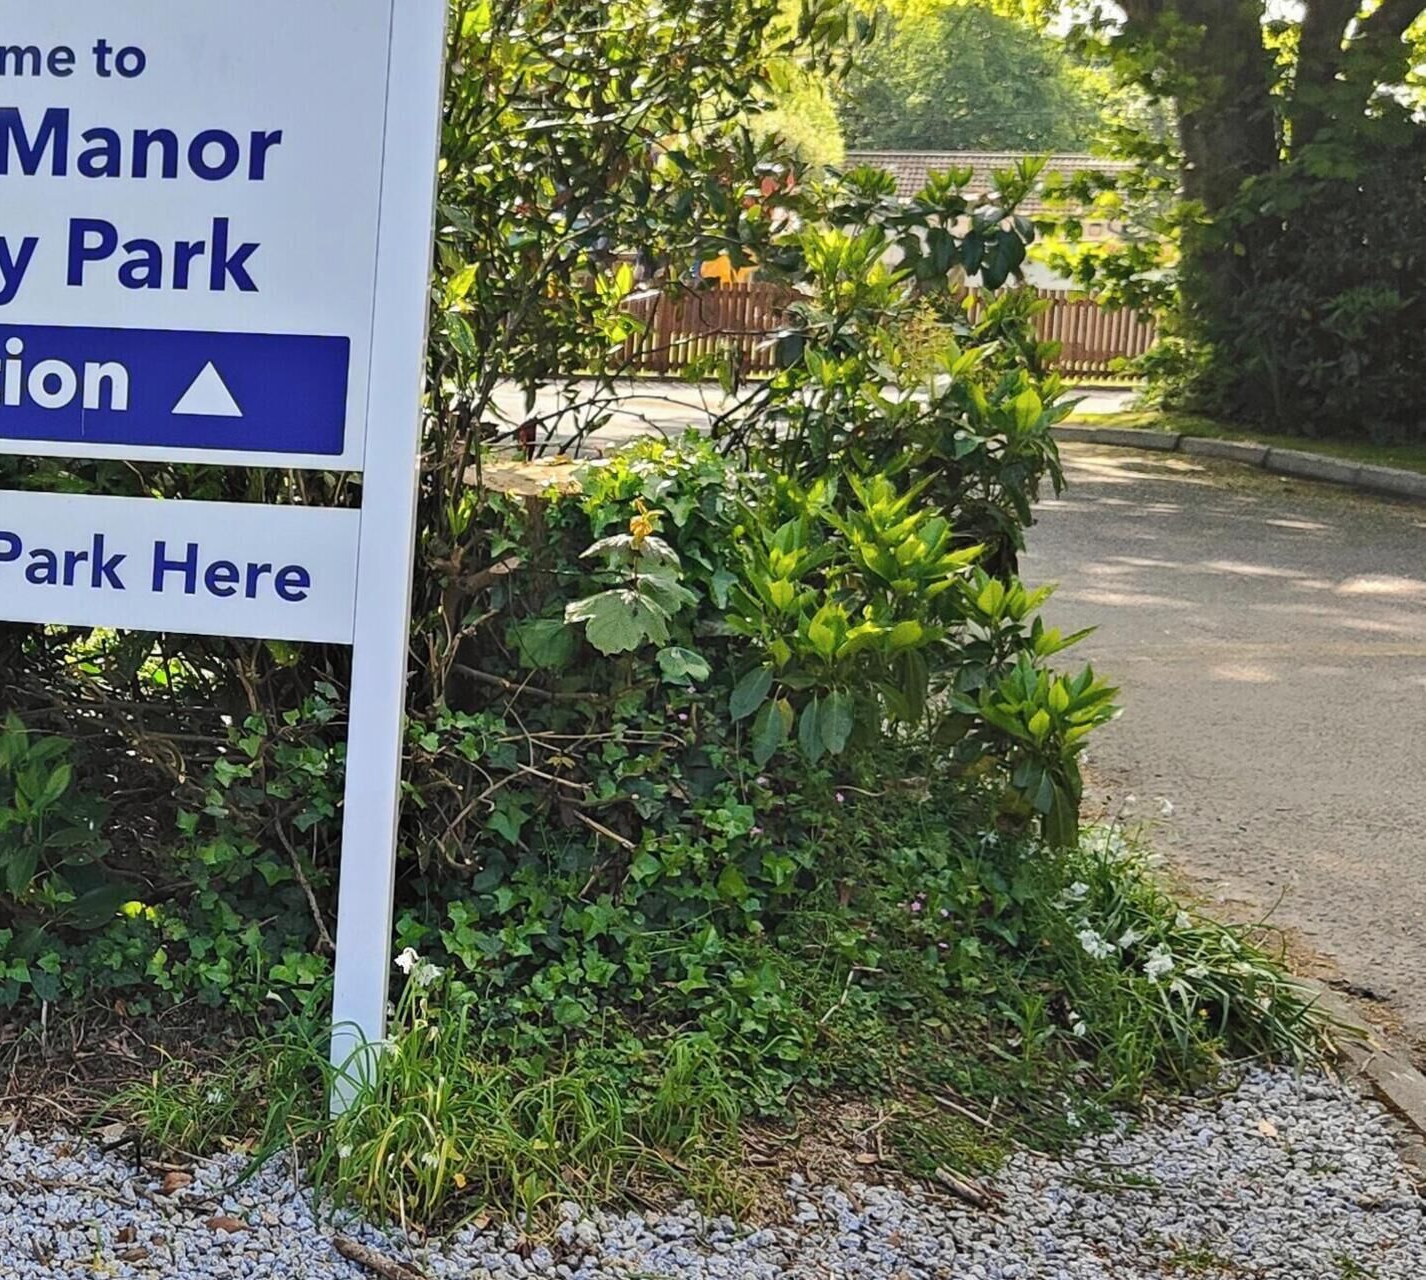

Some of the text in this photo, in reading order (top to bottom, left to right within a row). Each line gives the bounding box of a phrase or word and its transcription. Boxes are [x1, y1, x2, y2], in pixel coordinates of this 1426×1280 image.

[93, 39, 147, 80] to
[66, 218, 259, 292] Park
[152, 542, 312, 603] Here
